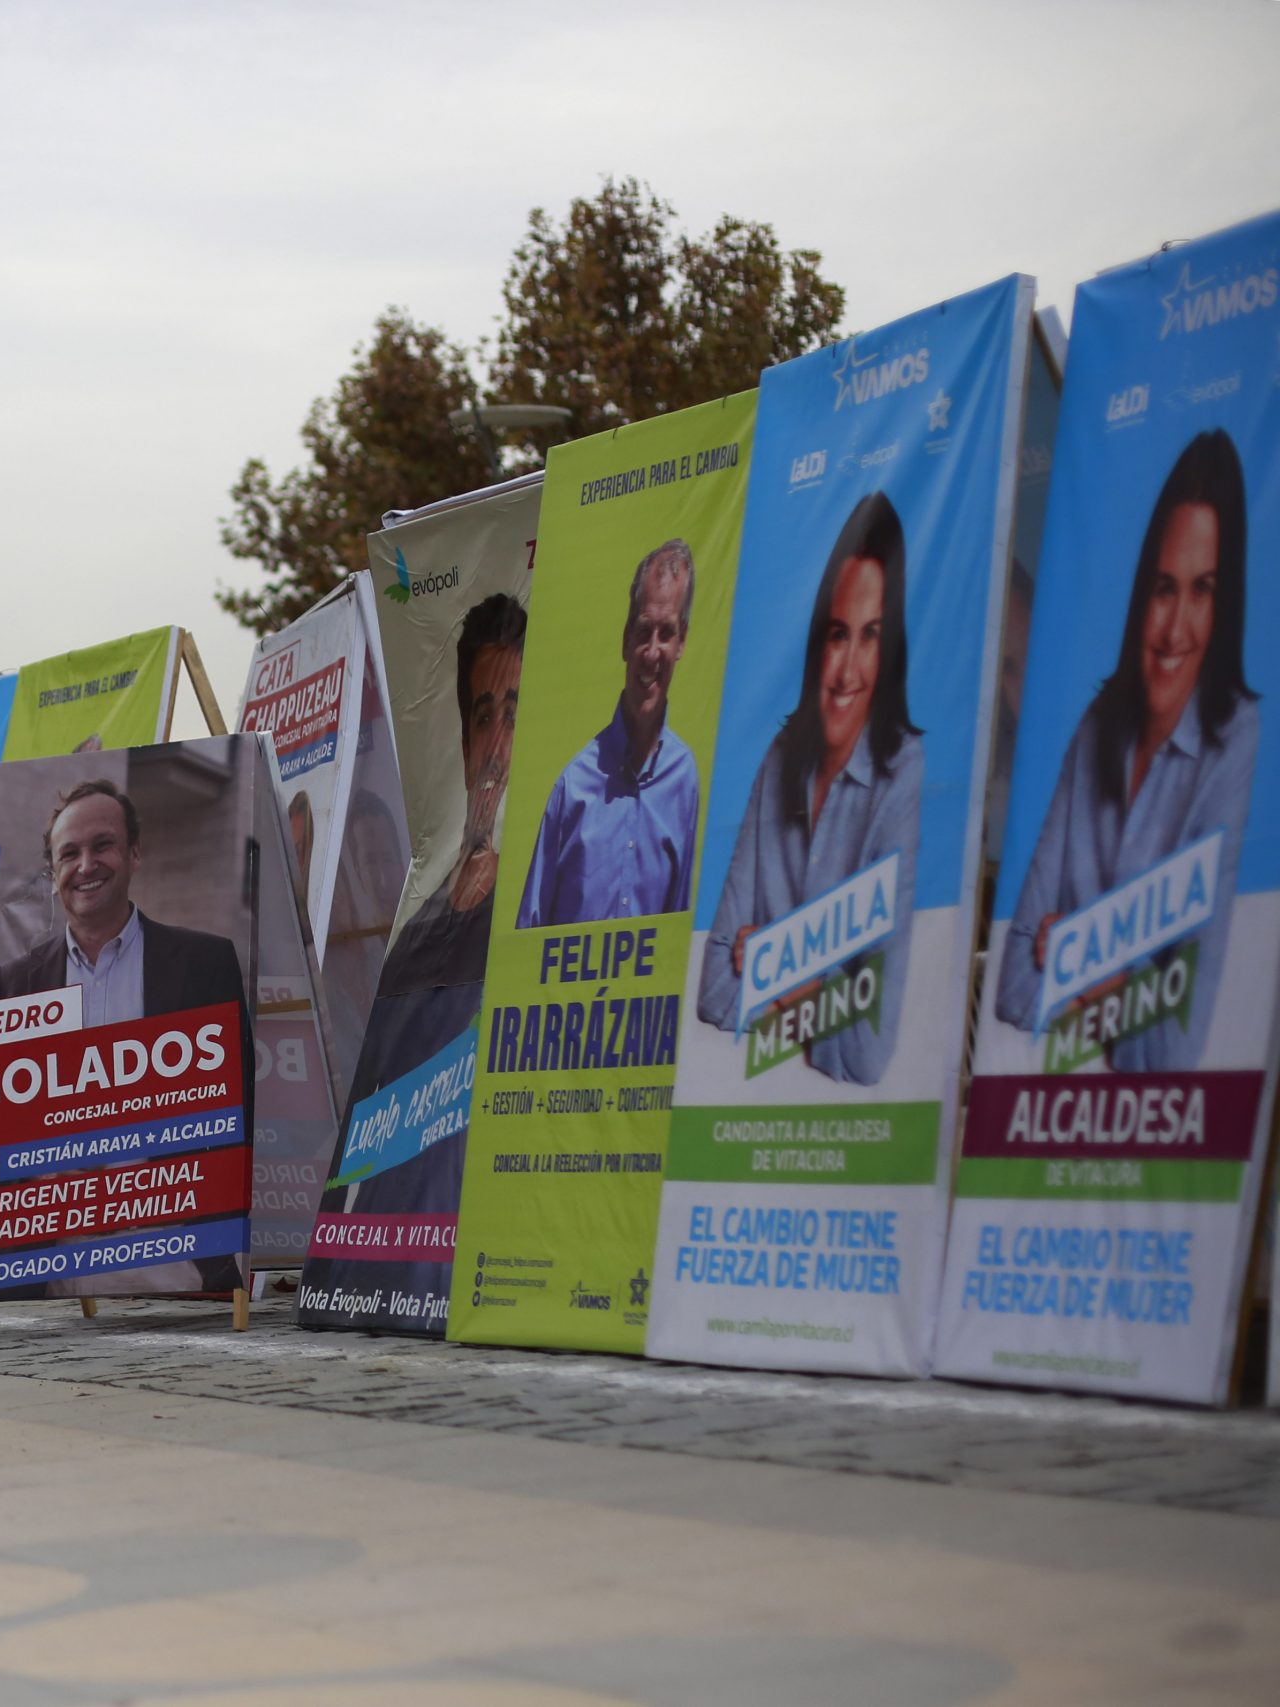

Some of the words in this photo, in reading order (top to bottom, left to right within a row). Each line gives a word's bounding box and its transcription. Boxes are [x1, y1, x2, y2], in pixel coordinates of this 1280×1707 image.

[1184, 268, 1279, 333] VAMOS
[853, 348, 930, 405] VAMOS
[580, 467, 646, 506] EXPERIENCIA
[649, 459, 676, 488] PARA
[680, 455, 692, 480] EL
[696, 442, 738, 476] CAMBIO
[411, 566, 460, 597] evópoli
[39, 684, 82, 708] EXPERIENCIA
[84, 679, 100, 697] PARA
[101, 676, 109, 693] EL
[256, 650, 294, 696] CATA
[242, 668, 341, 733] CHAPPUZEAU
[751, 877, 889, 991] CAMILA
[1053, 858, 1208, 987] CAMILA
[540, 928, 658, 985] FELIPE
[753, 967, 878, 1068] MERINO
[1051, 956, 1188, 1070] MERINO
[44, 1102, 119, 1126] CONCEJAL
[122, 1096, 152, 1113] POR
[155, 1083, 227, 1108] VITACURA
[492, 1086, 534, 1115] GESTIÓN
[546, 1088, 603, 1113] SEGURIDAD
[1006, 1088, 1205, 1145] ALCALDESA
[7, 1140, 84, 1169] CRISTIÁN
[87, 1133, 141, 1156] ARAYA
[159, 1116, 237, 1143] ALCALDE
[345, 1093, 400, 1159] LUCHO
[420, 1108, 463, 1152] FUERZA
[713, 1120, 793, 1142] CANDIDATA
[794, 1121, 806, 1141] A
[810, 1120, 892, 1141] ALCALDESA
[105, 1160, 204, 1195] VECINAL
[494, 1154, 531, 1172] CONCEJAL
[533, 1154, 539, 1172] A
[541, 1154, 552, 1172] LA
[554, 1150, 602, 1172] REELECCIÓN
[605, 1154, 620, 1172] POR
[623, 1153, 661, 1172] VITACURA
[752, 1150, 772, 1171] DE
[775, 1150, 846, 1171] VITACURA
[1046, 1162, 1066, 1186] DE
[1070, 1162, 1142, 1187] VITACURA
[65, 1207, 95, 1230] DE
[102, 1190, 197, 1224] FAMILIA
[689, 1206, 717, 1242] EL
[722, 1207, 819, 1247] CAMBIO
[825, 1209, 898, 1249] TIENE
[74, 1252, 84, 1269] Y
[89, 1234, 196, 1266] PROFESOR
[315, 1224, 388, 1247] CONCEJAL
[394, 1226, 404, 1247] X
[977, 1225, 1006, 1267] EL
[1012, 1227, 1112, 1271] CAMBIO
[1117, 1229, 1193, 1275] TIENE
[675, 1246, 769, 1287] FUERZA
[775, 1251, 811, 1289] DE
[814, 1254, 901, 1295] MUJER
[299, 1286, 328, 1311] Vota
[329, 1288, 382, 1318] Evópoli
[389, 1291, 421, 1316] Vota
[577, 1294, 611, 1310] VAMOS
[962, 1271, 1060, 1316] FUERZA
[1064, 1276, 1100, 1319] DE
[1103, 1279, 1194, 1325] MUJER
